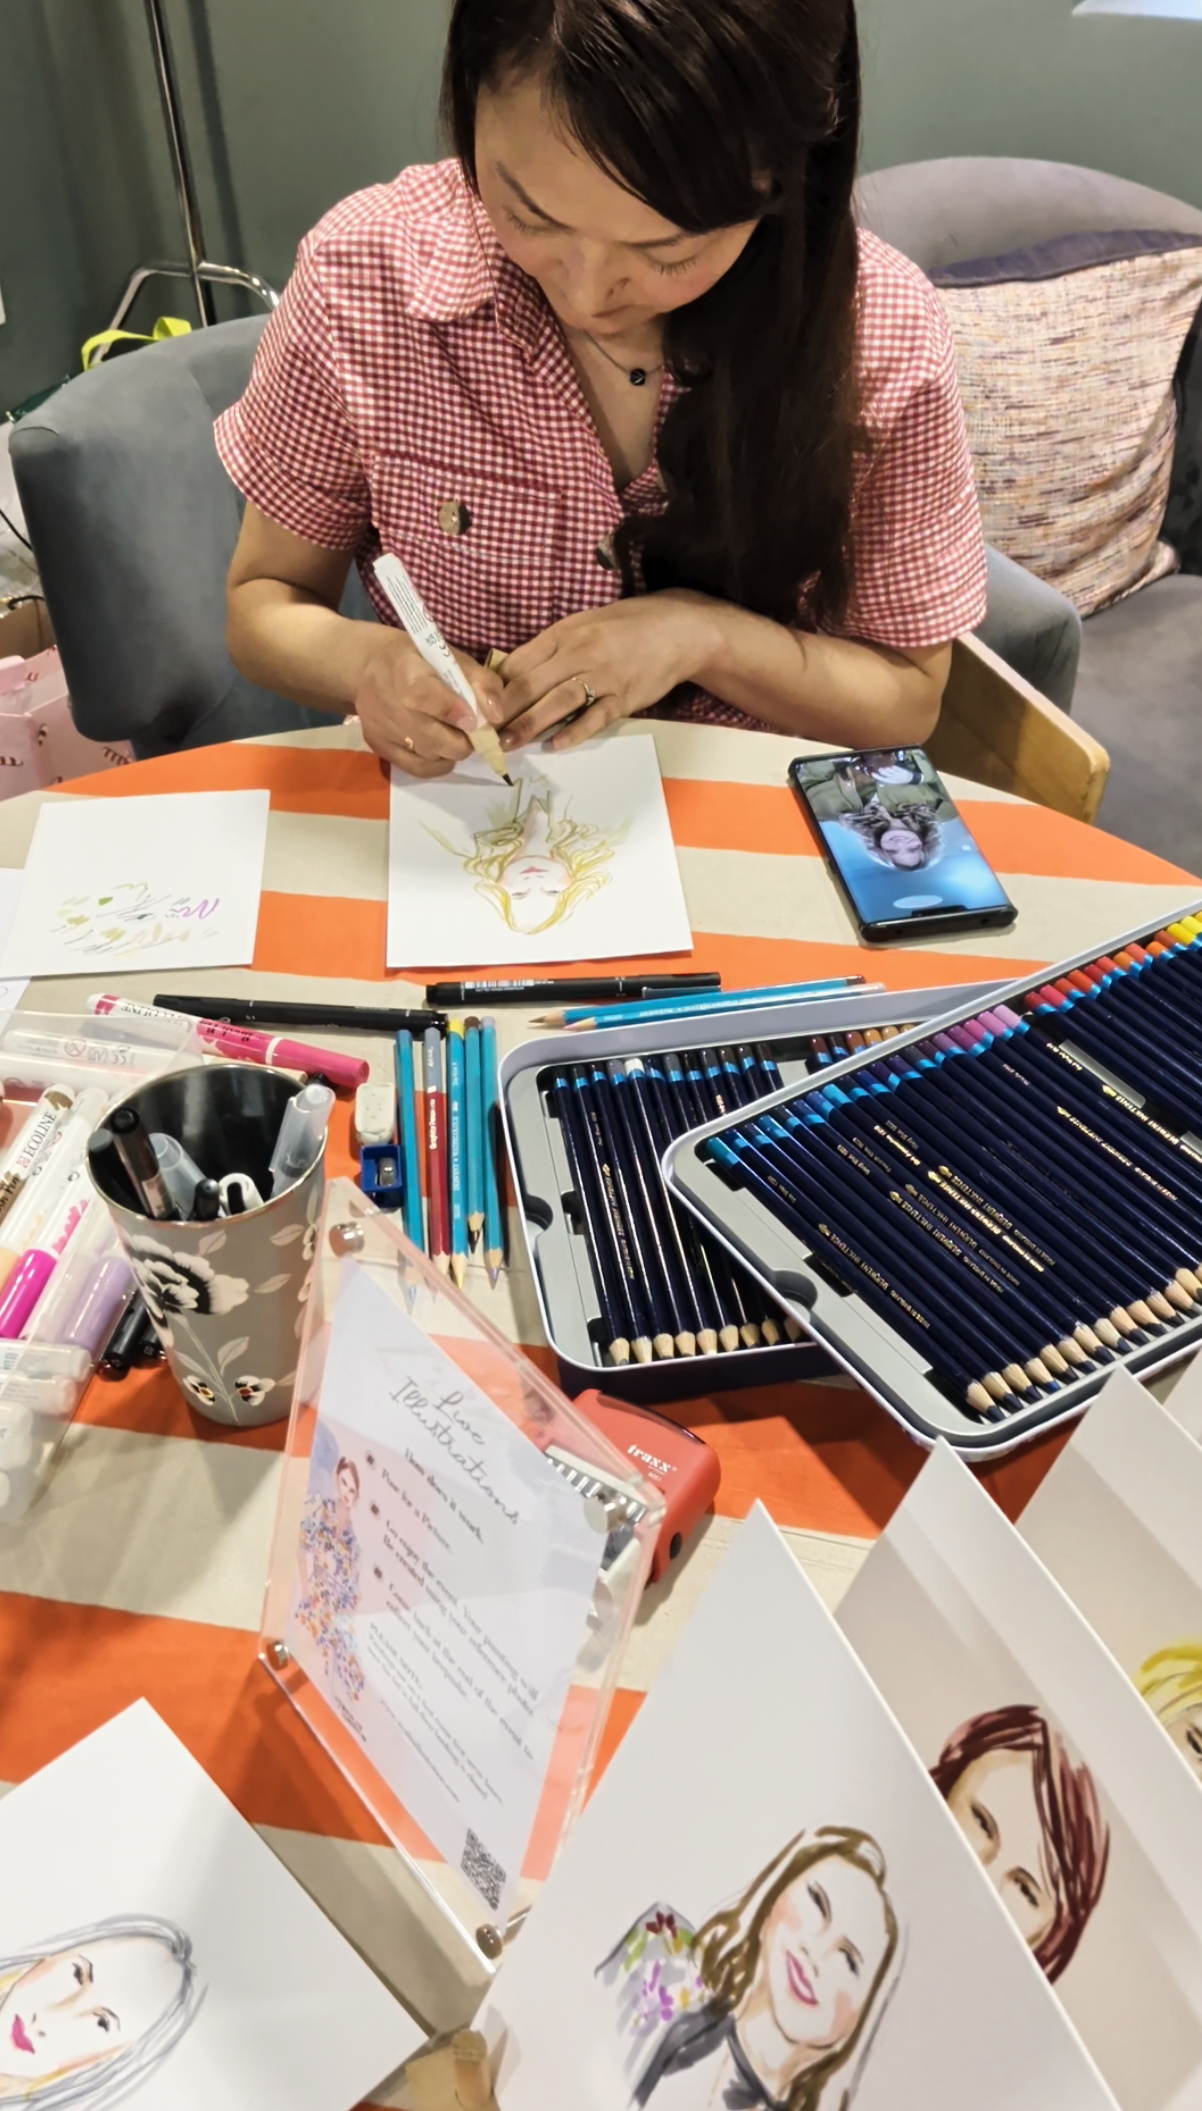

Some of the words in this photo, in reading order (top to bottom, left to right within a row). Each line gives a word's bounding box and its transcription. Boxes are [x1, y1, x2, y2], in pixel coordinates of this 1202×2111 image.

[21, 1109, 57, 1158] ECOLINE
[433, 1391, 483, 1444] Live
[390, 1378, 517, 1523] Illustrations
[405, 1449, 424, 1475] How
[427, 1475, 447, 1501] does
[627, 1443, 671, 1473] traxx
[422, 1561, 434, 1577] the
[499, 1718, 521, 1746] event
